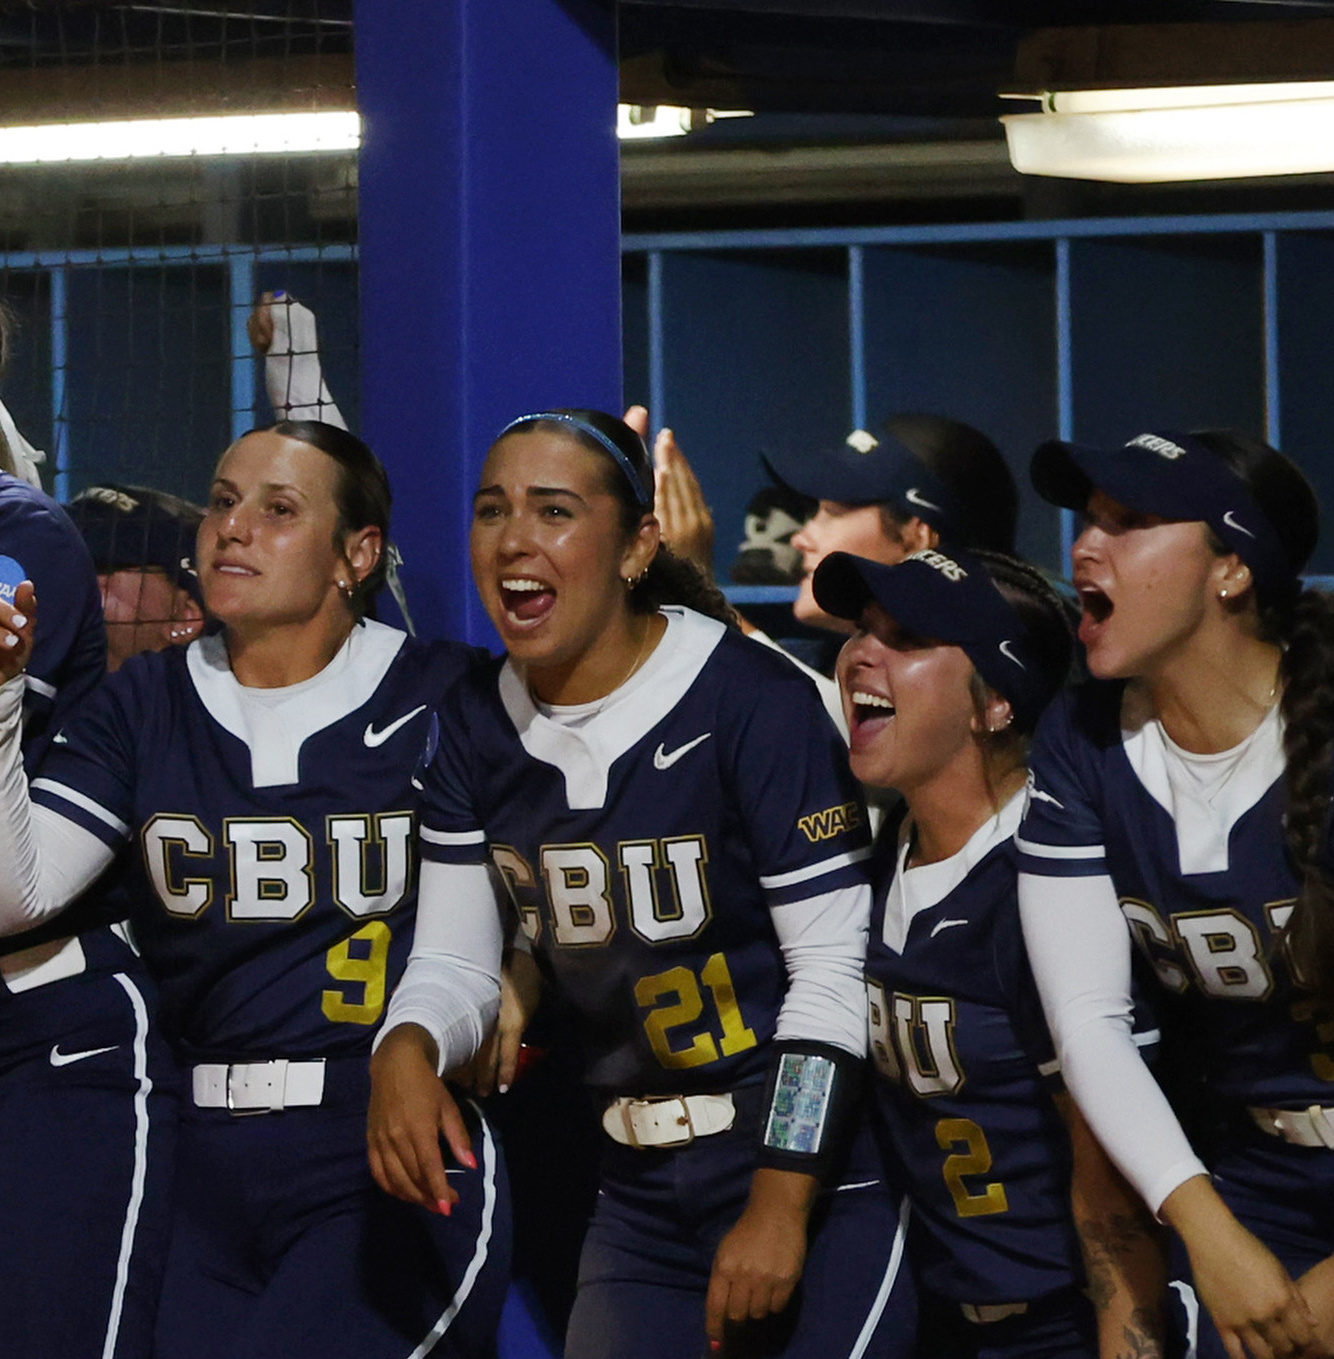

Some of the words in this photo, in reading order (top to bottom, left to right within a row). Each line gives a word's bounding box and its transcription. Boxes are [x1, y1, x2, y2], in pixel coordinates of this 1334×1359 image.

[1125, 433, 1186, 460] CERS
[906, 549, 968, 581] CERS
[141, 810, 415, 923] CBU
[321, 920, 392, 1025] 9
[634, 952, 757, 1070] 21
[935, 1118, 1009, 1218] 2
